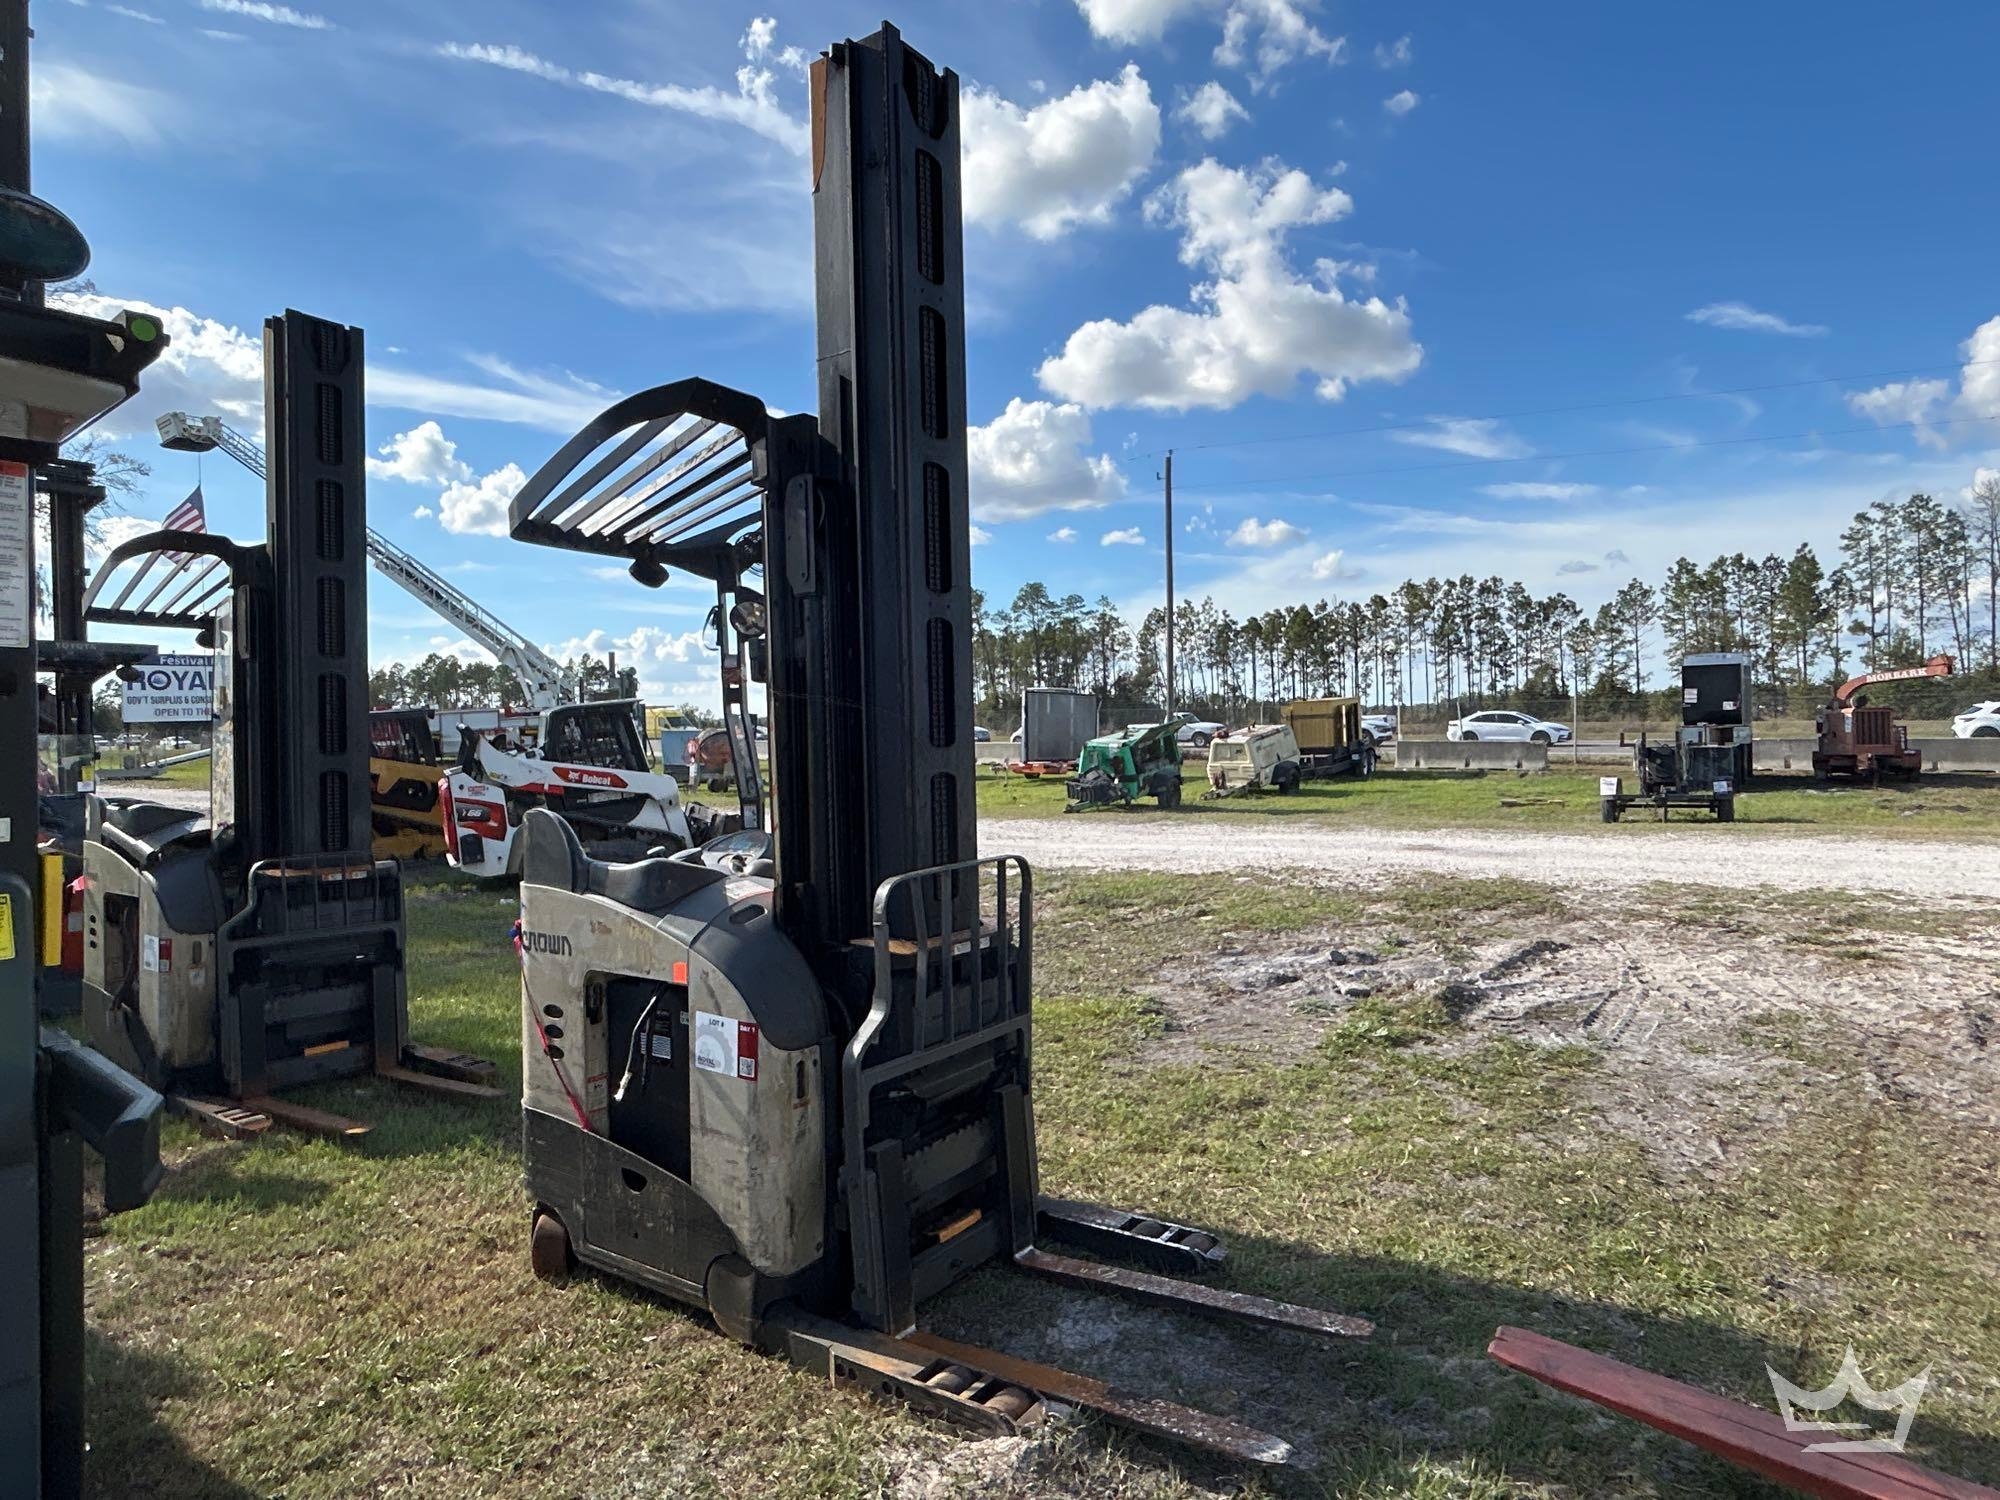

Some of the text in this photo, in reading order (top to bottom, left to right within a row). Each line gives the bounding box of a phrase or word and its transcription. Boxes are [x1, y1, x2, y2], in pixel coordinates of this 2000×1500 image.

[160, 656, 207, 665] Festival
[1866, 668, 1927, 682] MORBARK
[151, 696, 182, 704] SURPLUS
[155, 708, 178, 716] OPEN
[180, 708, 193, 716] TO
[582, 774, 611, 785] Bobcat
